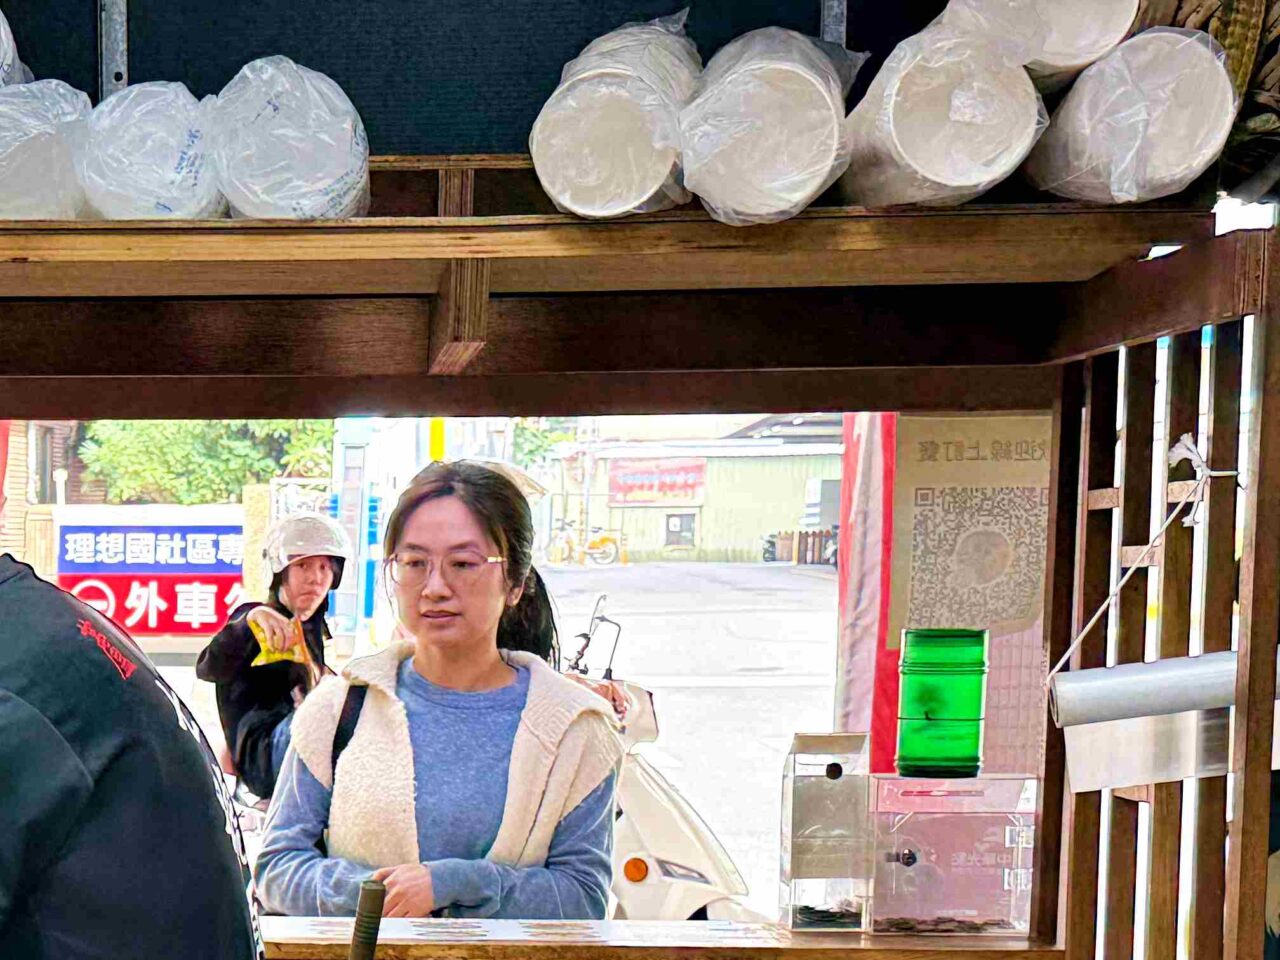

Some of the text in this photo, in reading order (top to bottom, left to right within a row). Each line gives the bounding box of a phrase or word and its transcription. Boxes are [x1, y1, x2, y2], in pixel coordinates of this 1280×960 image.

[64, 533, 243, 565] 理想國社區專
